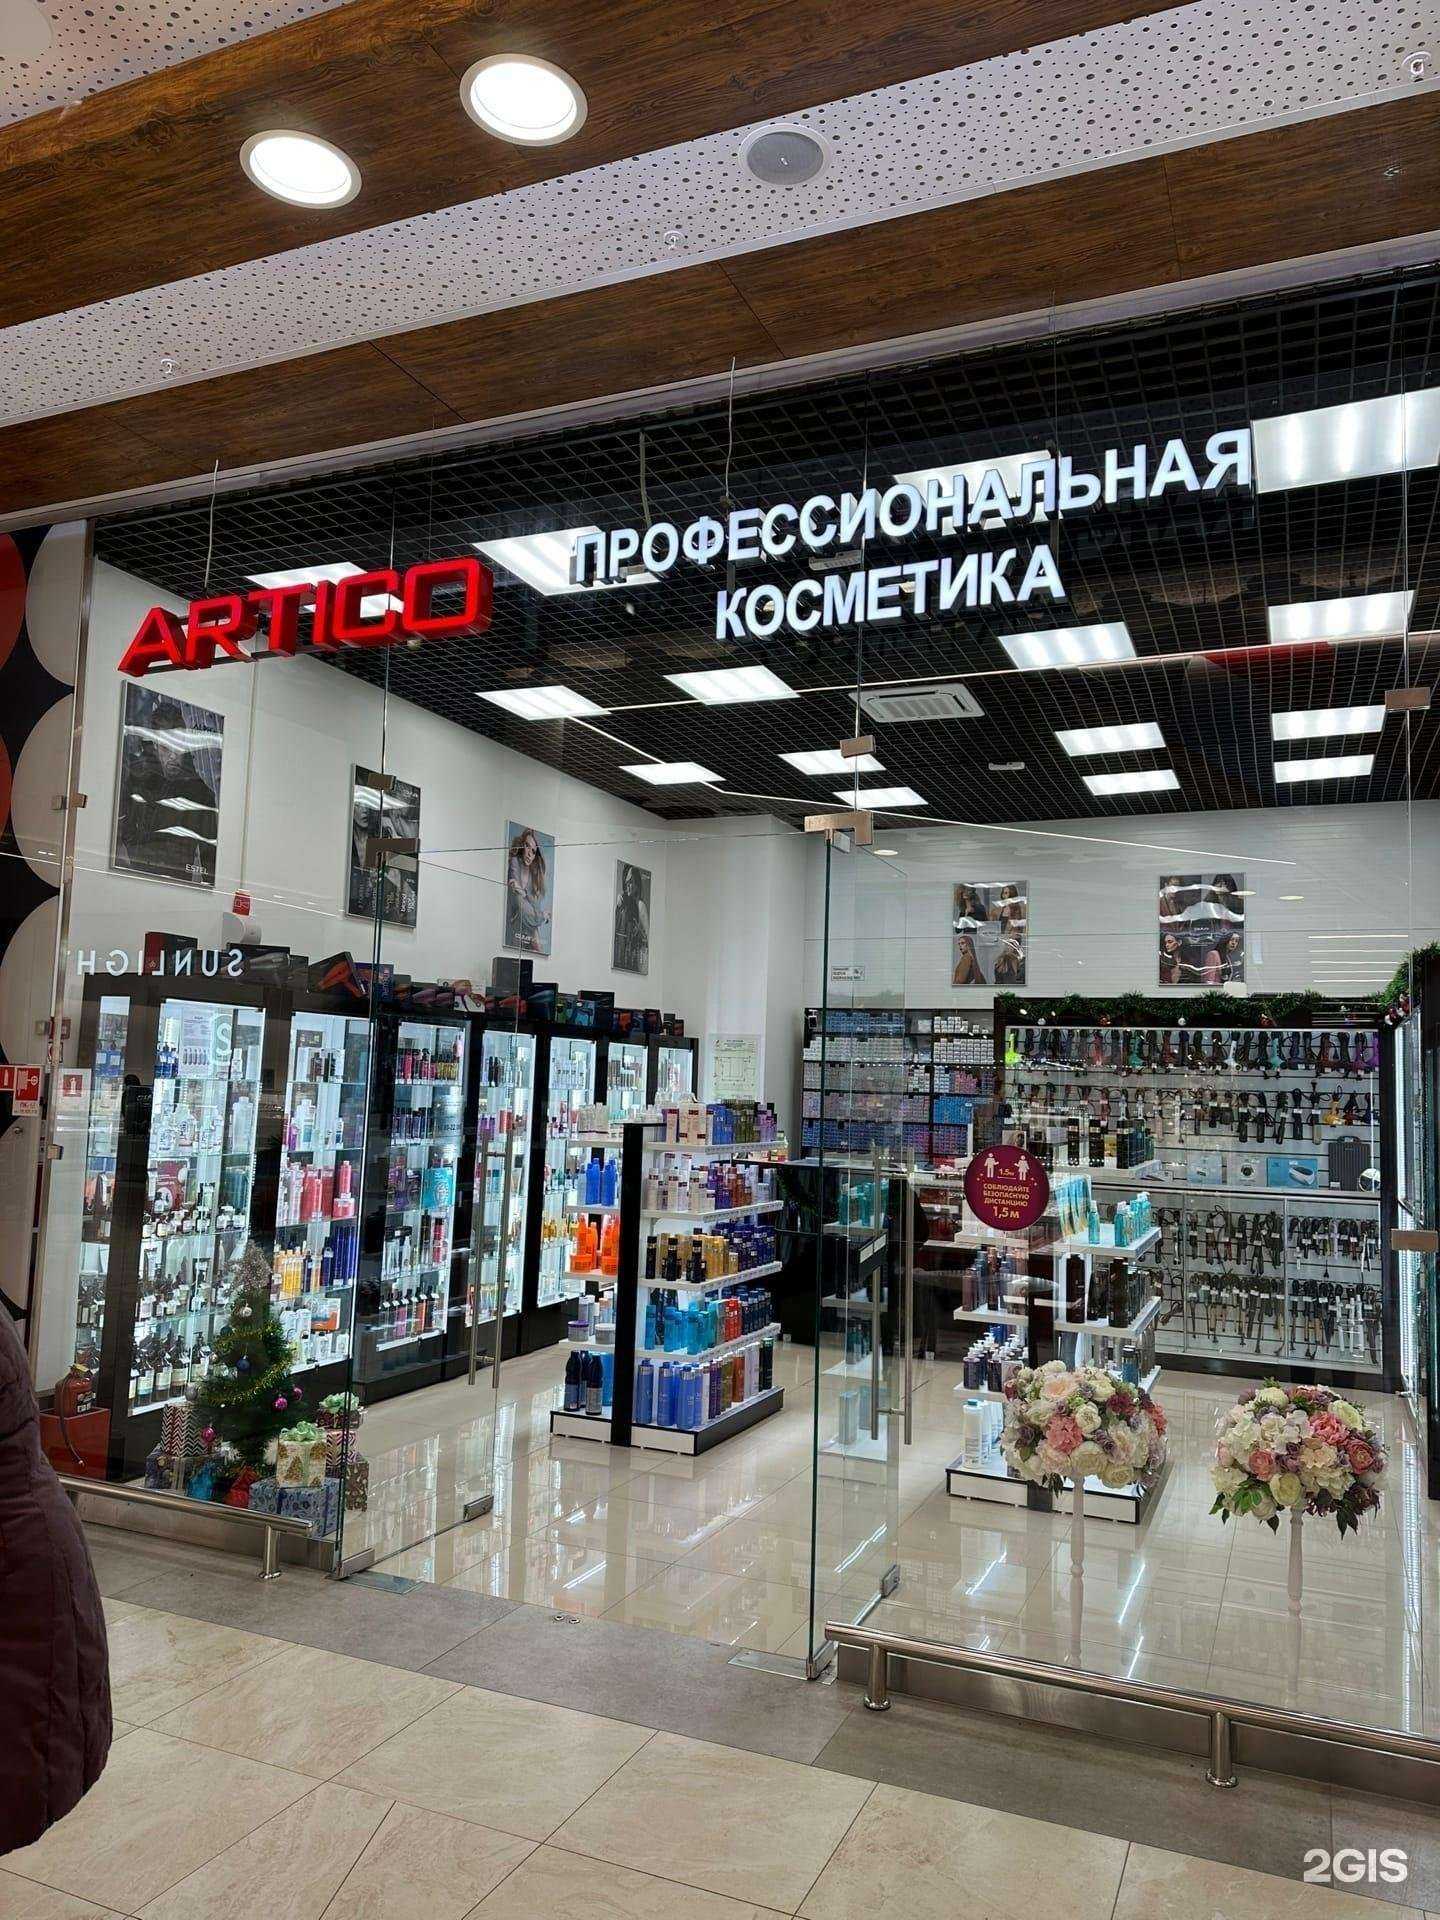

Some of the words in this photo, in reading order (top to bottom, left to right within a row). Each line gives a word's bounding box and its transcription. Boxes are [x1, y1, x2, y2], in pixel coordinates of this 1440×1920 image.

[574, 428, 1252, 584] ПРОФЕССИОНАЛЬНАЯ
[714, 543, 1067, 640] КОСМЕТИКА
[118, 557, 492, 676] ARTICO
[185, 863, 208, 875] ESTEL
[983, 1183, 1029, 1192] СОБЛЮДАЙТЕ
[983, 1190, 1030, 1200] БЕЗОПАСНУЮ
[984, 1198, 1028, 1207] ДИСТАНЦИЮ
